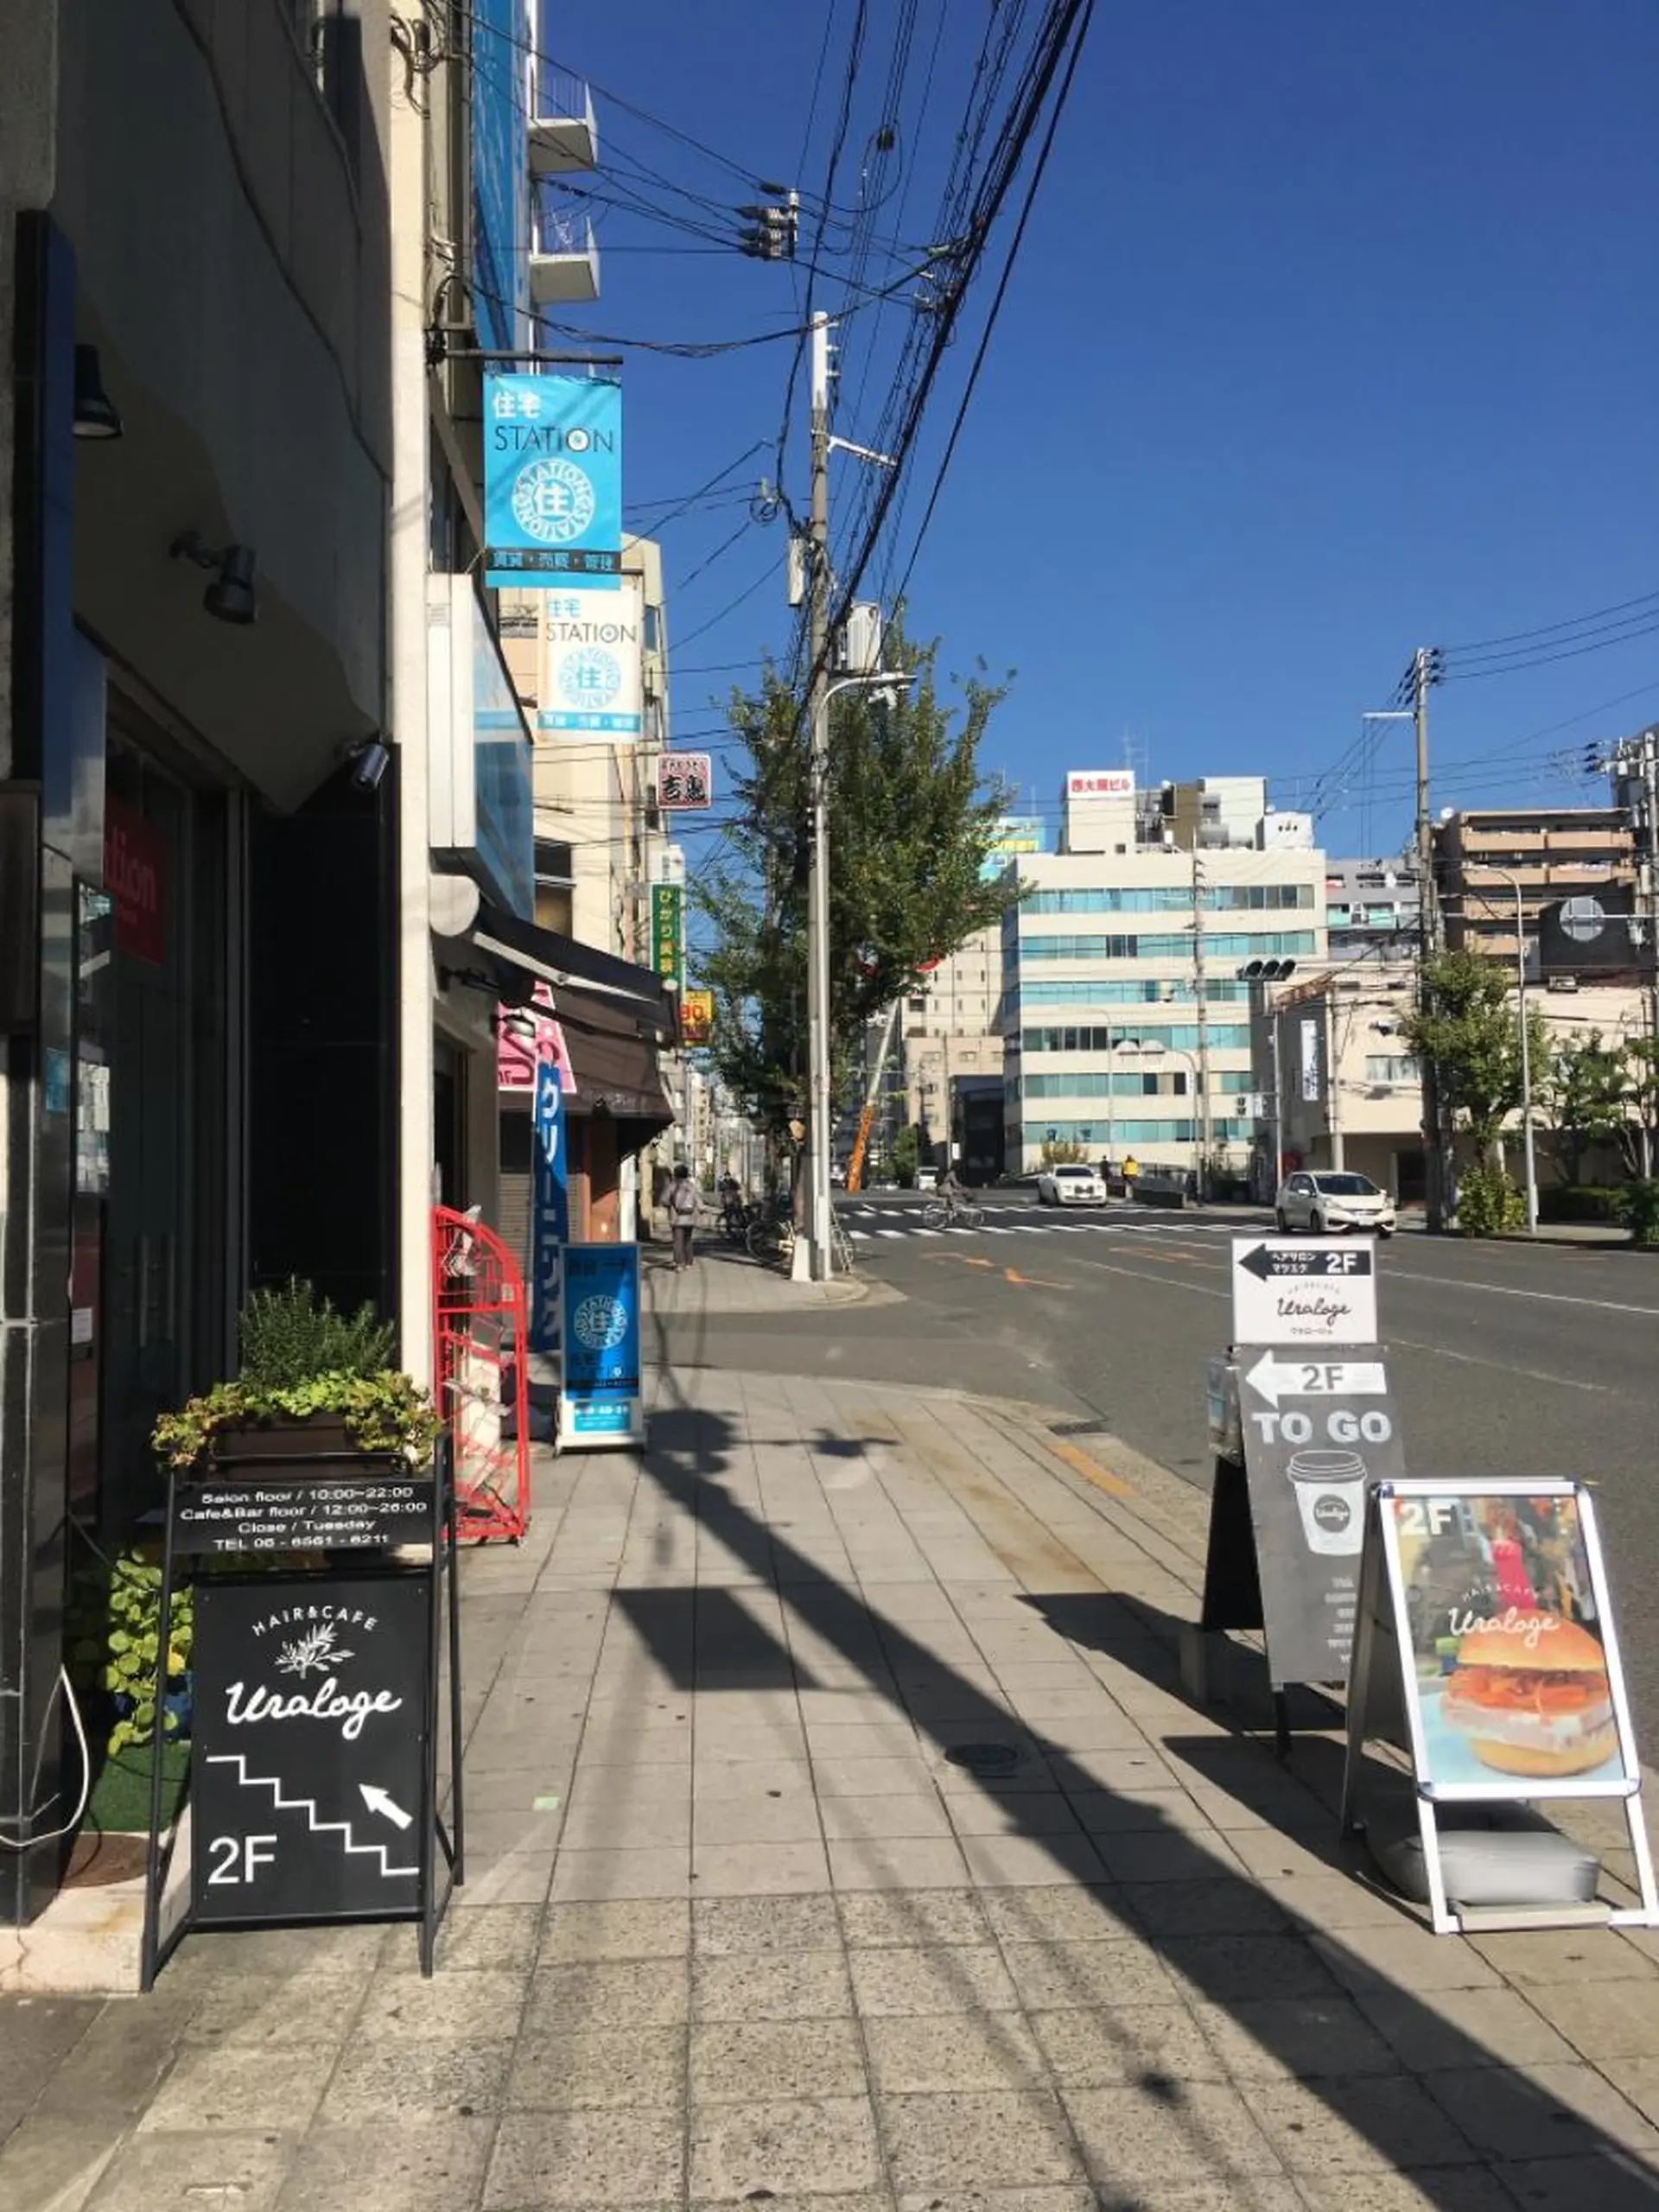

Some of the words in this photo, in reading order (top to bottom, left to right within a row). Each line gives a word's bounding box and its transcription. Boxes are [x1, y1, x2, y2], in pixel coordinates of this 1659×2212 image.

[493, 391, 541, 418] 住宅
[494, 425, 613, 453] STATION
[533, 482, 569, 517] 住
[547, 599, 581, 617] 住宅
[546, 622, 637, 643] STATION
[576, 664, 602, 690] 住
[1325, 1252, 1357, 1274] 2F
[1276, 1297, 1352, 1326] Uraloge
[1302, 1365, 1344, 1391] 2F
[1251, 1412, 1313, 1445] TO
[1327, 1410, 1393, 1444] GO
[201, 1493, 249, 1504] Salon
[256, 1491, 292, 1503] floor
[181, 1506, 264, 1521] Cafe&Bar
[270, 1505, 305, 1518] floor
[238, 1521, 287, 1534] Close
[302, 1519, 377, 1533] Tuesday
[1400, 1503, 1452, 1535] 2F
[213, 1539, 248, 1552] TEL
[254, 1537, 276, 1549] 06
[251, 1605, 379, 1637] HAIR&CAFE
[1447, 1605, 1561, 1649] Uraloge
[225, 1677, 404, 1740] Uraloge
[207, 1834, 278, 1885] 2F
